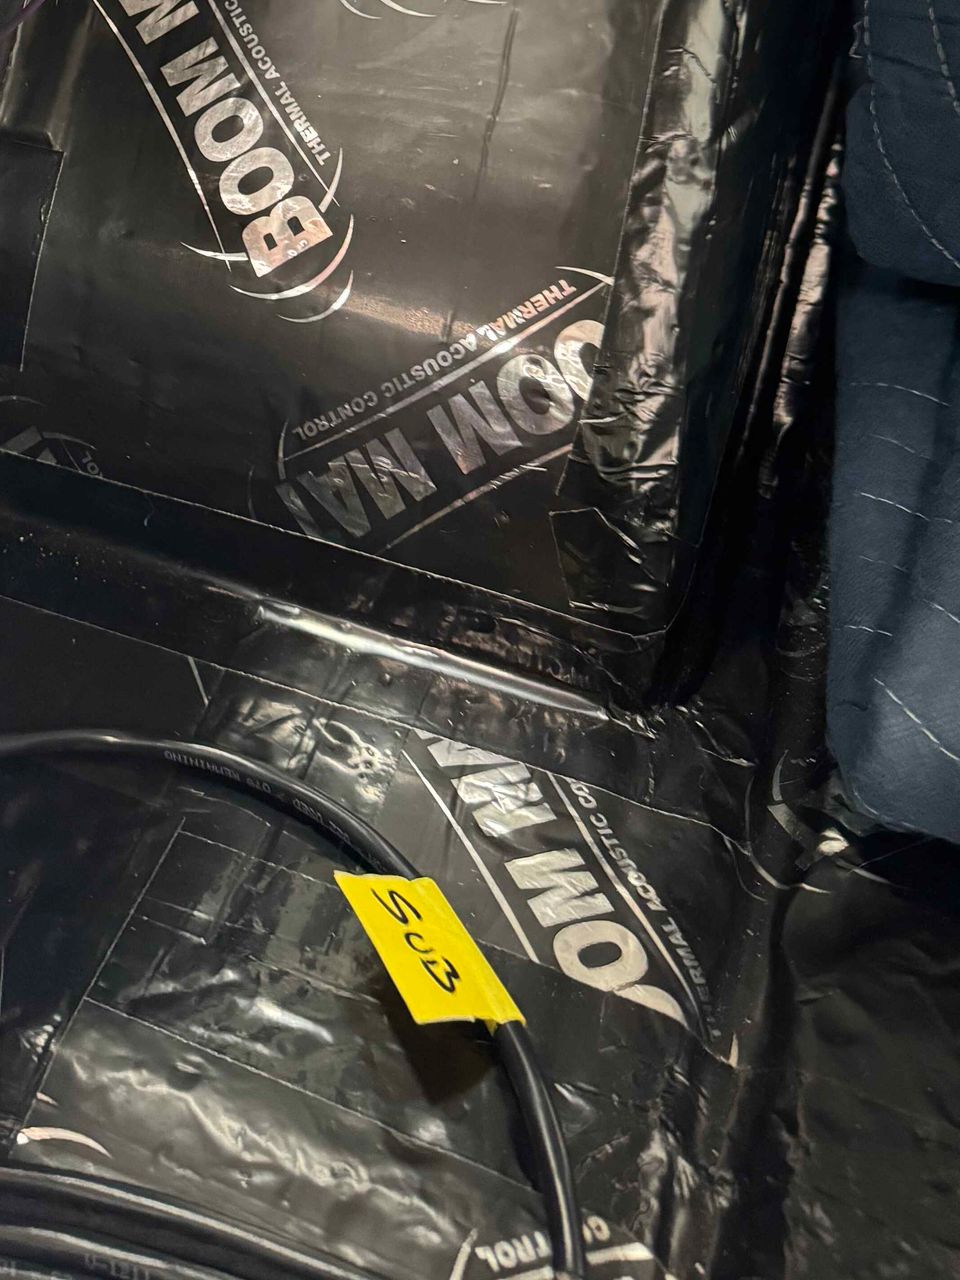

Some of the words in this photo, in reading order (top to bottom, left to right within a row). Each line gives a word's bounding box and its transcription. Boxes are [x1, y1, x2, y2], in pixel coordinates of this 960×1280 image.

[160, 35, 334, 278] BOOM
[274, 82, 332, 166] THERMAL
[475, 278, 578, 342] THERMAL
[382, 332, 478, 398] ACOUSTIC
[291, 394, 380, 441] CONTROL
[589, 812, 668, 912] ACOUSTIC
[372, 887, 462, 997] SUB
